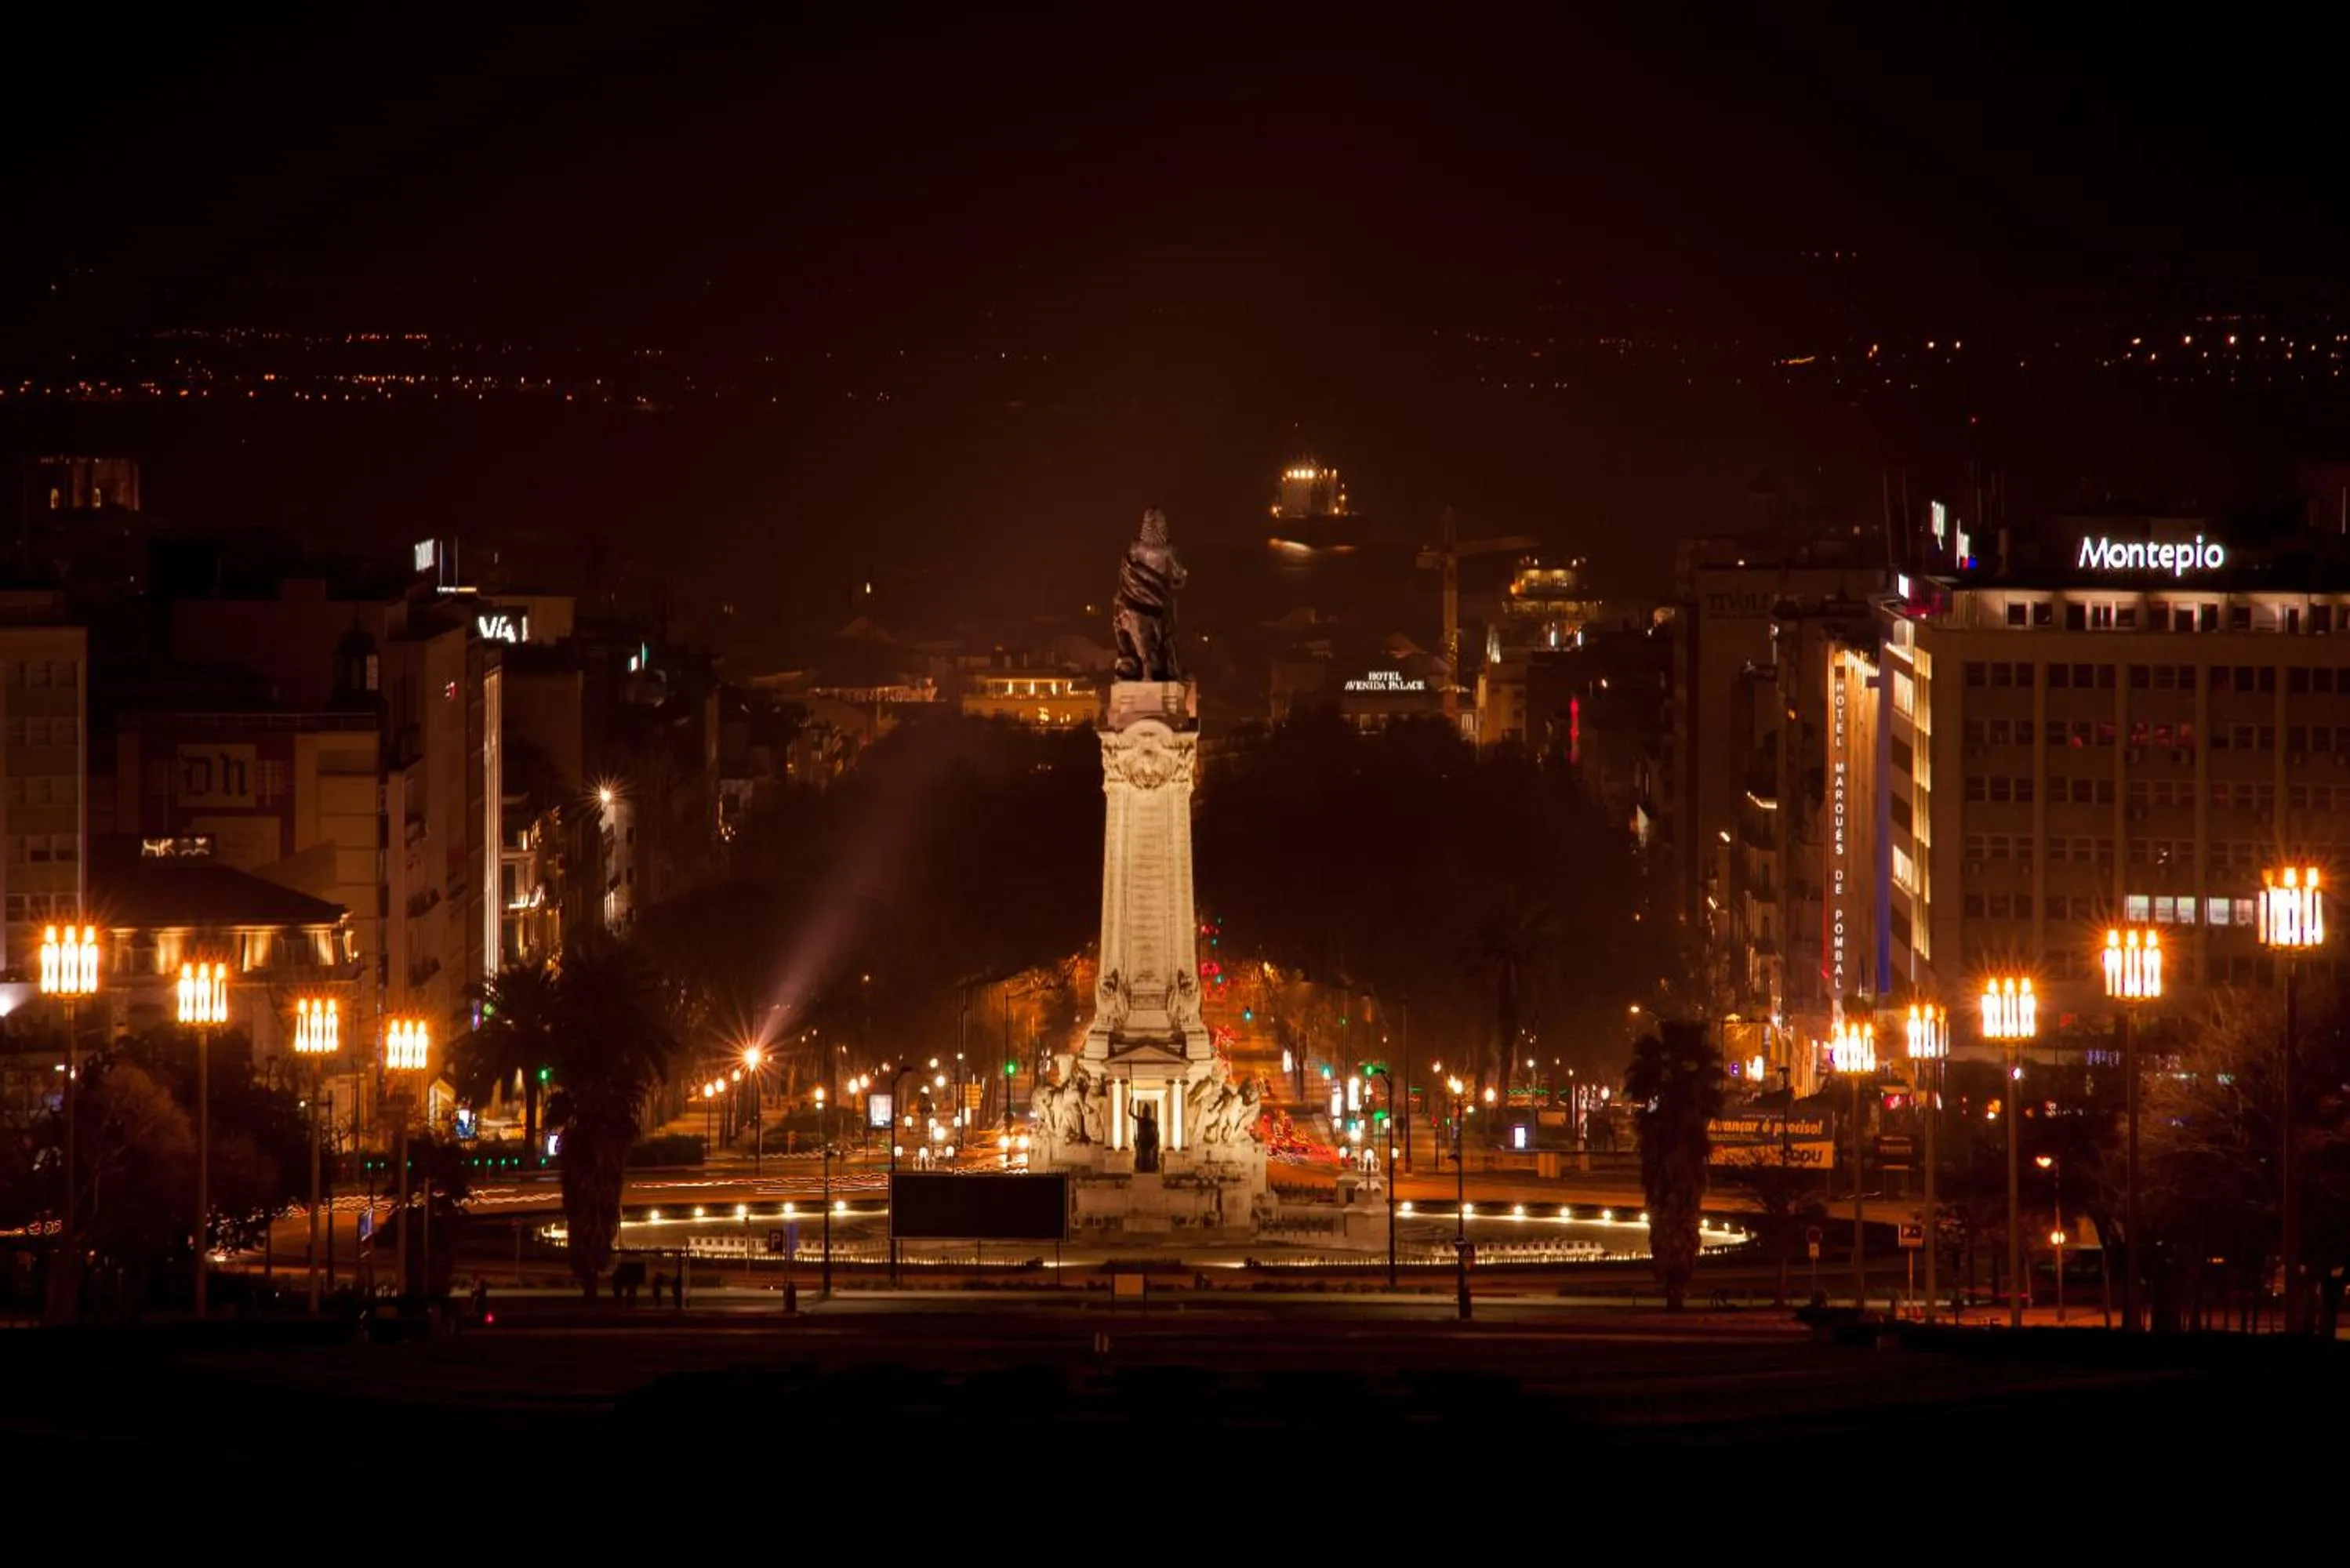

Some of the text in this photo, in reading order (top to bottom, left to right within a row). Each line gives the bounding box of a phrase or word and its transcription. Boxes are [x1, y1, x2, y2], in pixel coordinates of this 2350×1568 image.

[2079, 533, 2224, 576] Montepio
[1345, 681, 1425, 690] AVENIDA PALACE
[1369, 671, 1401, 681] HOTEL
[1836, 683, 1844, 746] HOTEL
[1835, 870, 1843, 894] DE
[1834, 909, 1843, 988] POMBAL
[1773, 1119, 1823, 1136] peciso!
